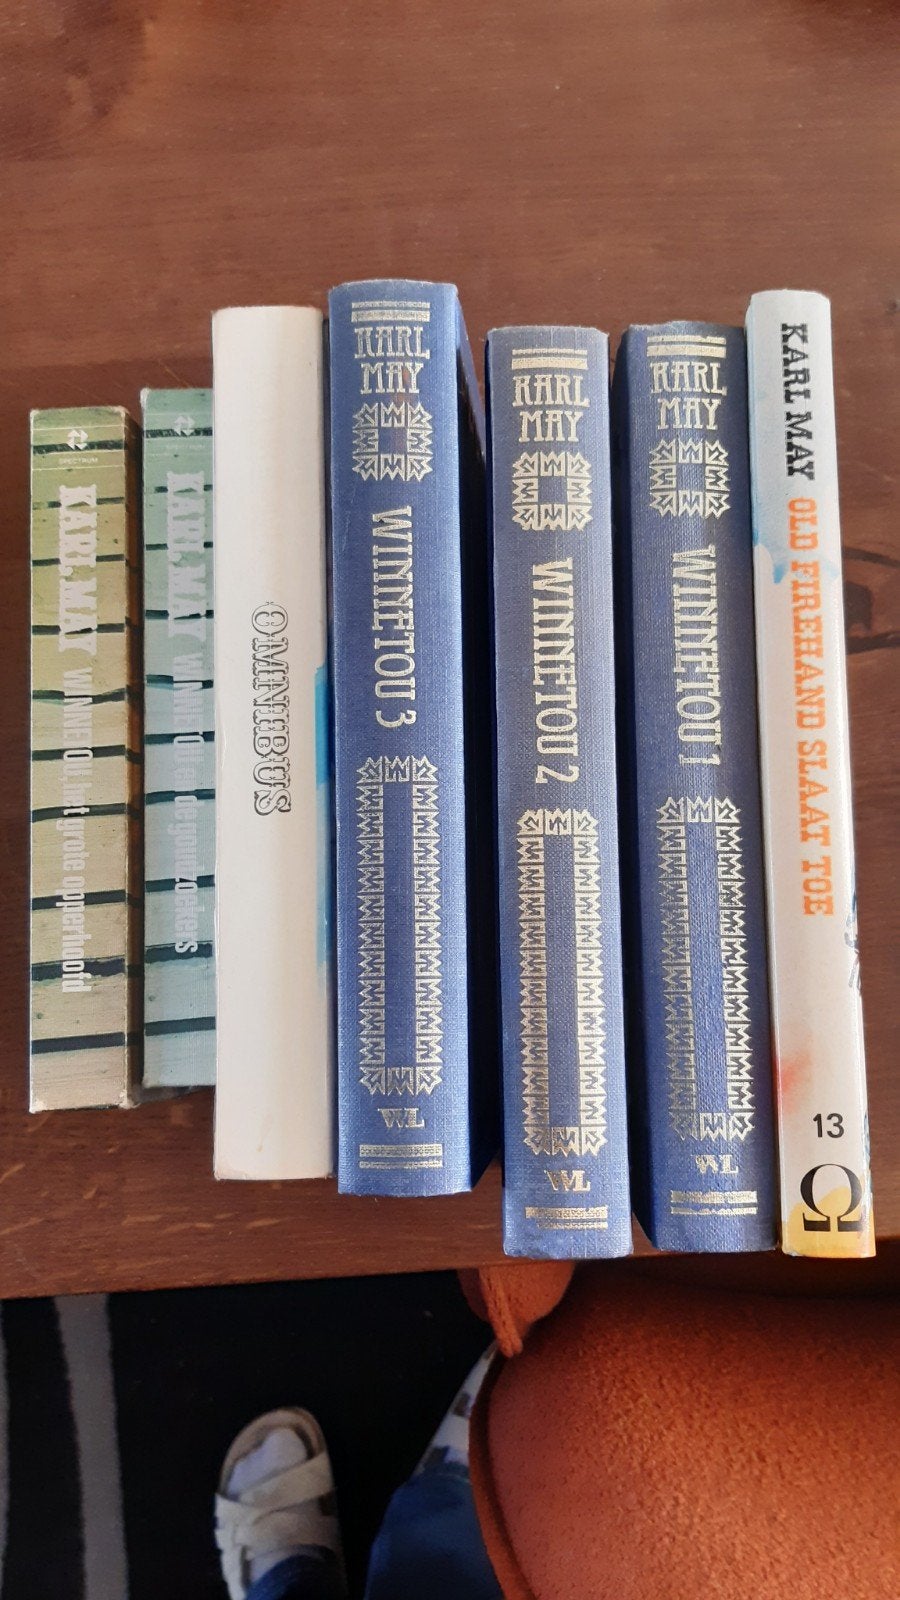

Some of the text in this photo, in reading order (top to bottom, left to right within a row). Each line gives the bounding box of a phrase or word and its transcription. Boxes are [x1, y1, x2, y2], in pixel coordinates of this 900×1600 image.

[353, 325, 430, 360] KARL
[360, 361, 424, 394] MAY
[512, 374, 590, 408] KARL
[650, 360, 727, 396] KARL
[518, 410, 583, 443] MAY
[657, 398, 722, 430] MAY
[58, 483, 97, 577] KARL
[166, 470, 205, 569] KARL
[58, 577, 97, 655] MAY
[167, 564, 206, 641] MAY
[372, 505, 417, 728] WINNETOU 3
[780, 323, 834, 917] KARL MAY OLD FIREHAND SLAAT TOE
[532, 557, 580, 784] WINNETOU 2
[672, 544, 722, 766] WINNETOU 1
[251, 601, 291, 816] OMNIBUS
[56, 818, 89, 871] grote
[56, 876, 92, 993] opperhoofd
[377, 1107, 425, 1128] WL
[813, 1112, 845, 1139] 13
[543, 1169, 592, 1192] WL
[690, 1154, 739, 1174] WL
